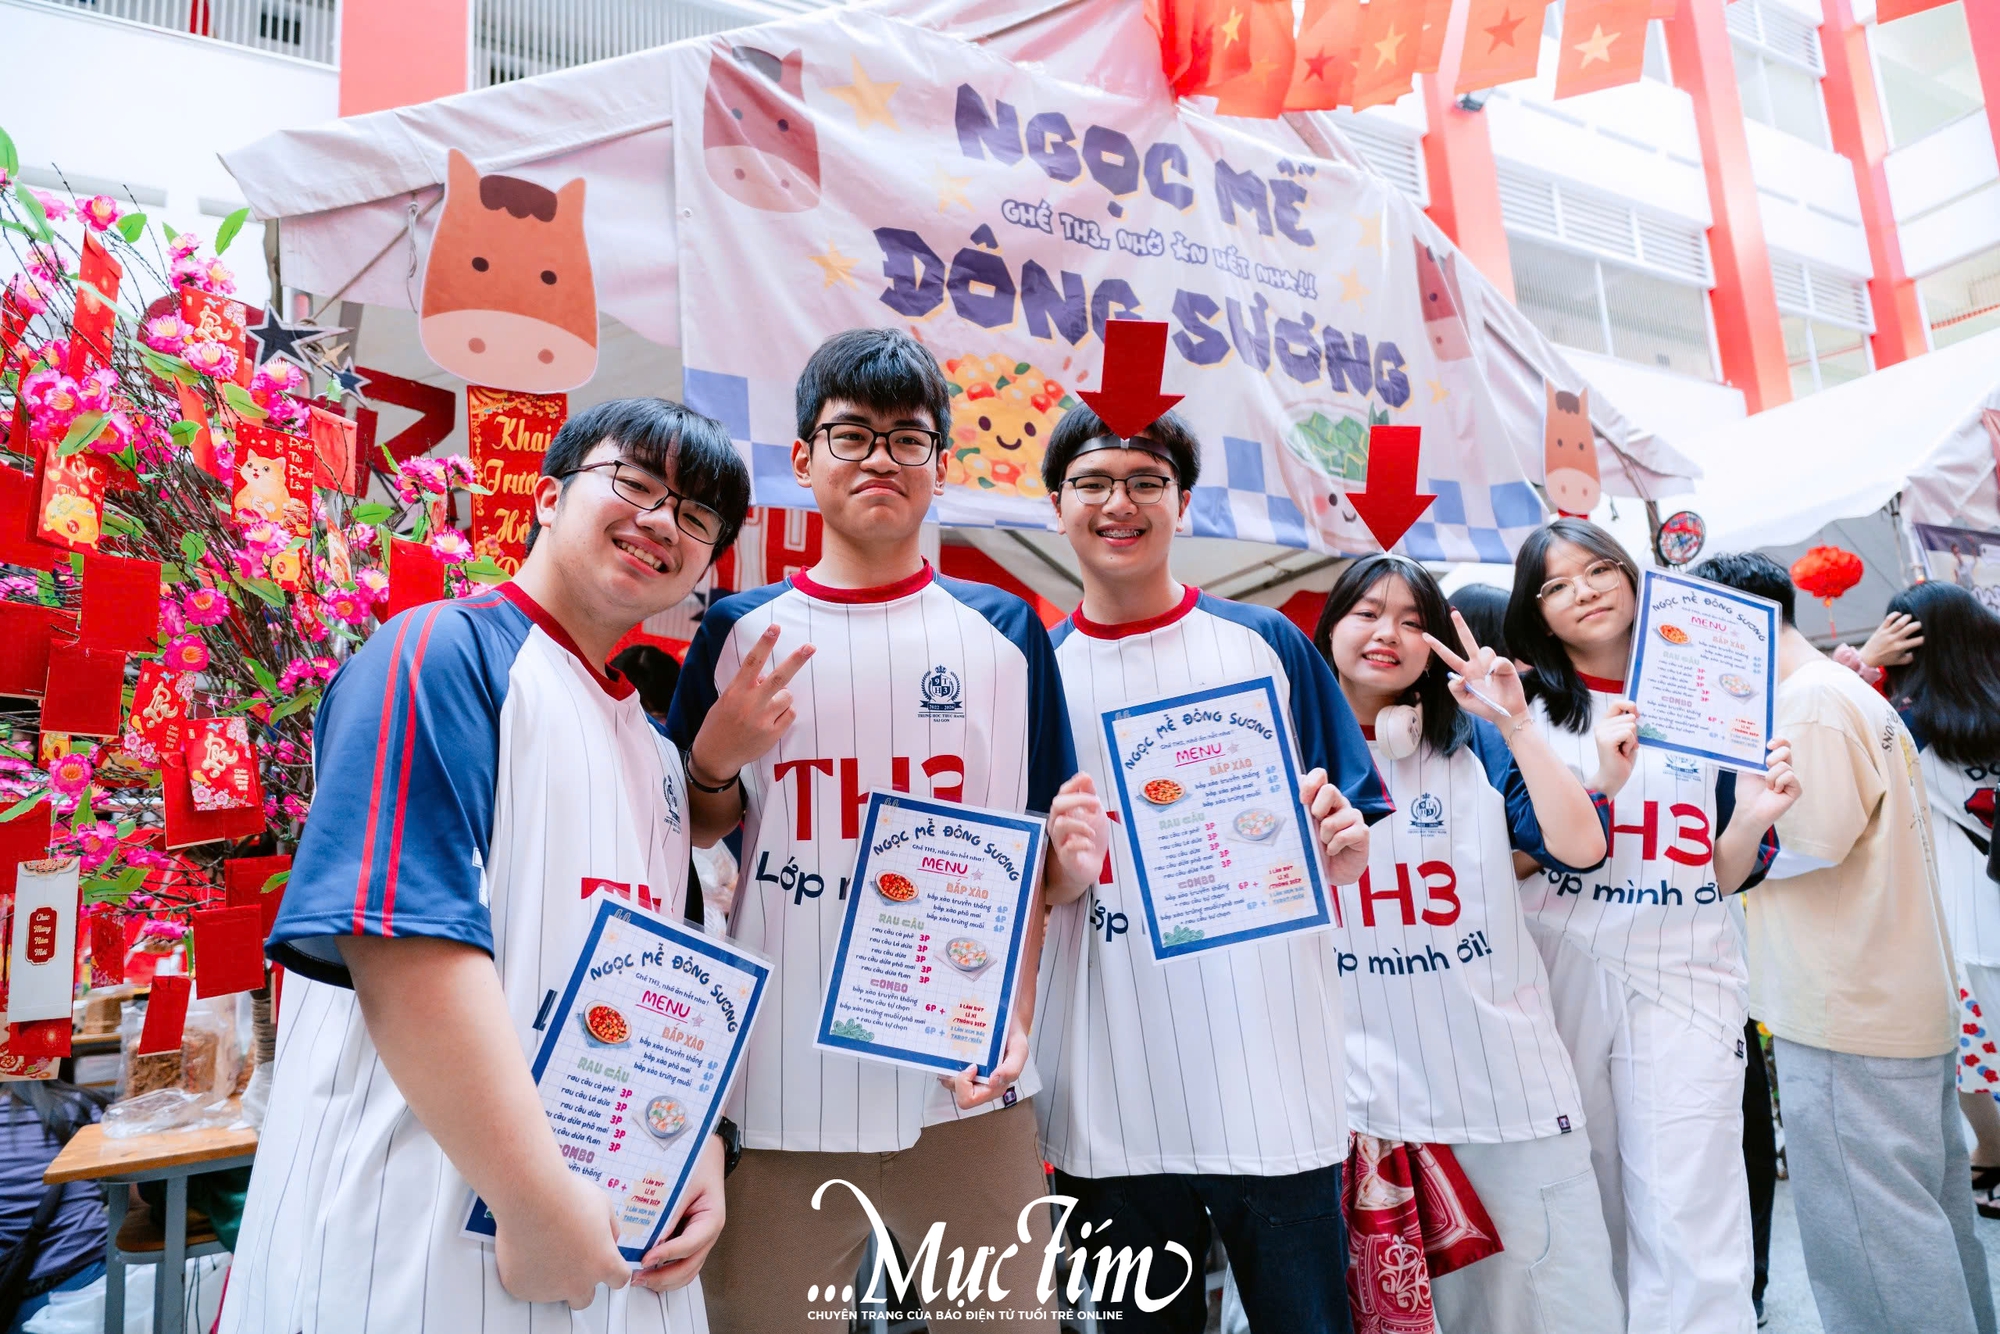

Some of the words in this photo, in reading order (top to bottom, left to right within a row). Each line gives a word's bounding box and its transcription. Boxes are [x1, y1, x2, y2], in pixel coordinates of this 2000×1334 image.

[954, 82, 1197, 219] NGỌC
[1001, 198, 1054, 235] GHÉ
[1212, 244, 1250, 280] HẾT
[1171, 287, 1411, 409] SƯƠNG
[491, 414, 553, 453] Khai
[484, 457, 540, 496] Trươ
[494, 507, 532, 545] Hồ
[1691, 616, 1727, 632] MENU
[1125, 737, 1154, 770] NGỌC
[1182, 708, 1222, 725] ĐÔNG
[1229, 712, 1273, 740] SƯƠNG
[1176, 743, 1222, 763] MENU
[1209, 762, 1230, 776] BẮP
[1231, 758, 1253, 771] XÀO
[1607, 799, 1713, 867] H3
[873, 831, 909, 855] NGỌC
[915, 818, 935, 839] MỄ
[943, 824, 981, 846] ĐÔNG
[983, 843, 1019, 881] SƯƠNG
[755, 850, 825, 906] Lớp
[922, 857, 968, 875] MENU
[946, 879, 968, 895] BẮP
[968, 886, 989, 900] XÀO
[1178, 874, 1215, 889] COMBO
[1593, 879, 1683, 906] mình
[878, 913, 900, 926] RAU
[901, 917, 925, 931] CÂU
[1368, 944, 1451, 976] mình
[590, 954, 634, 981] NGỌC
[641, 943, 664, 967] MỄ
[672, 955, 710, 985] ĐÔNG
[707, 984, 738, 1033] SƯƠNG
[870, 979, 908, 993] COMBO
[642, 991, 690, 1018] MENU
[925, 1004, 937, 1012] 6P
[662, 1023, 684, 1043] BẮP
[683, 1035, 705, 1051] XÀO
[924, 1026, 936, 1035] 6P
[577, 1057, 603, 1075] RAU
[604, 1066, 630, 1083] CÂU
[559, 1144, 595, 1164] OMBO
[607, 1178, 620, 1188] 6P
